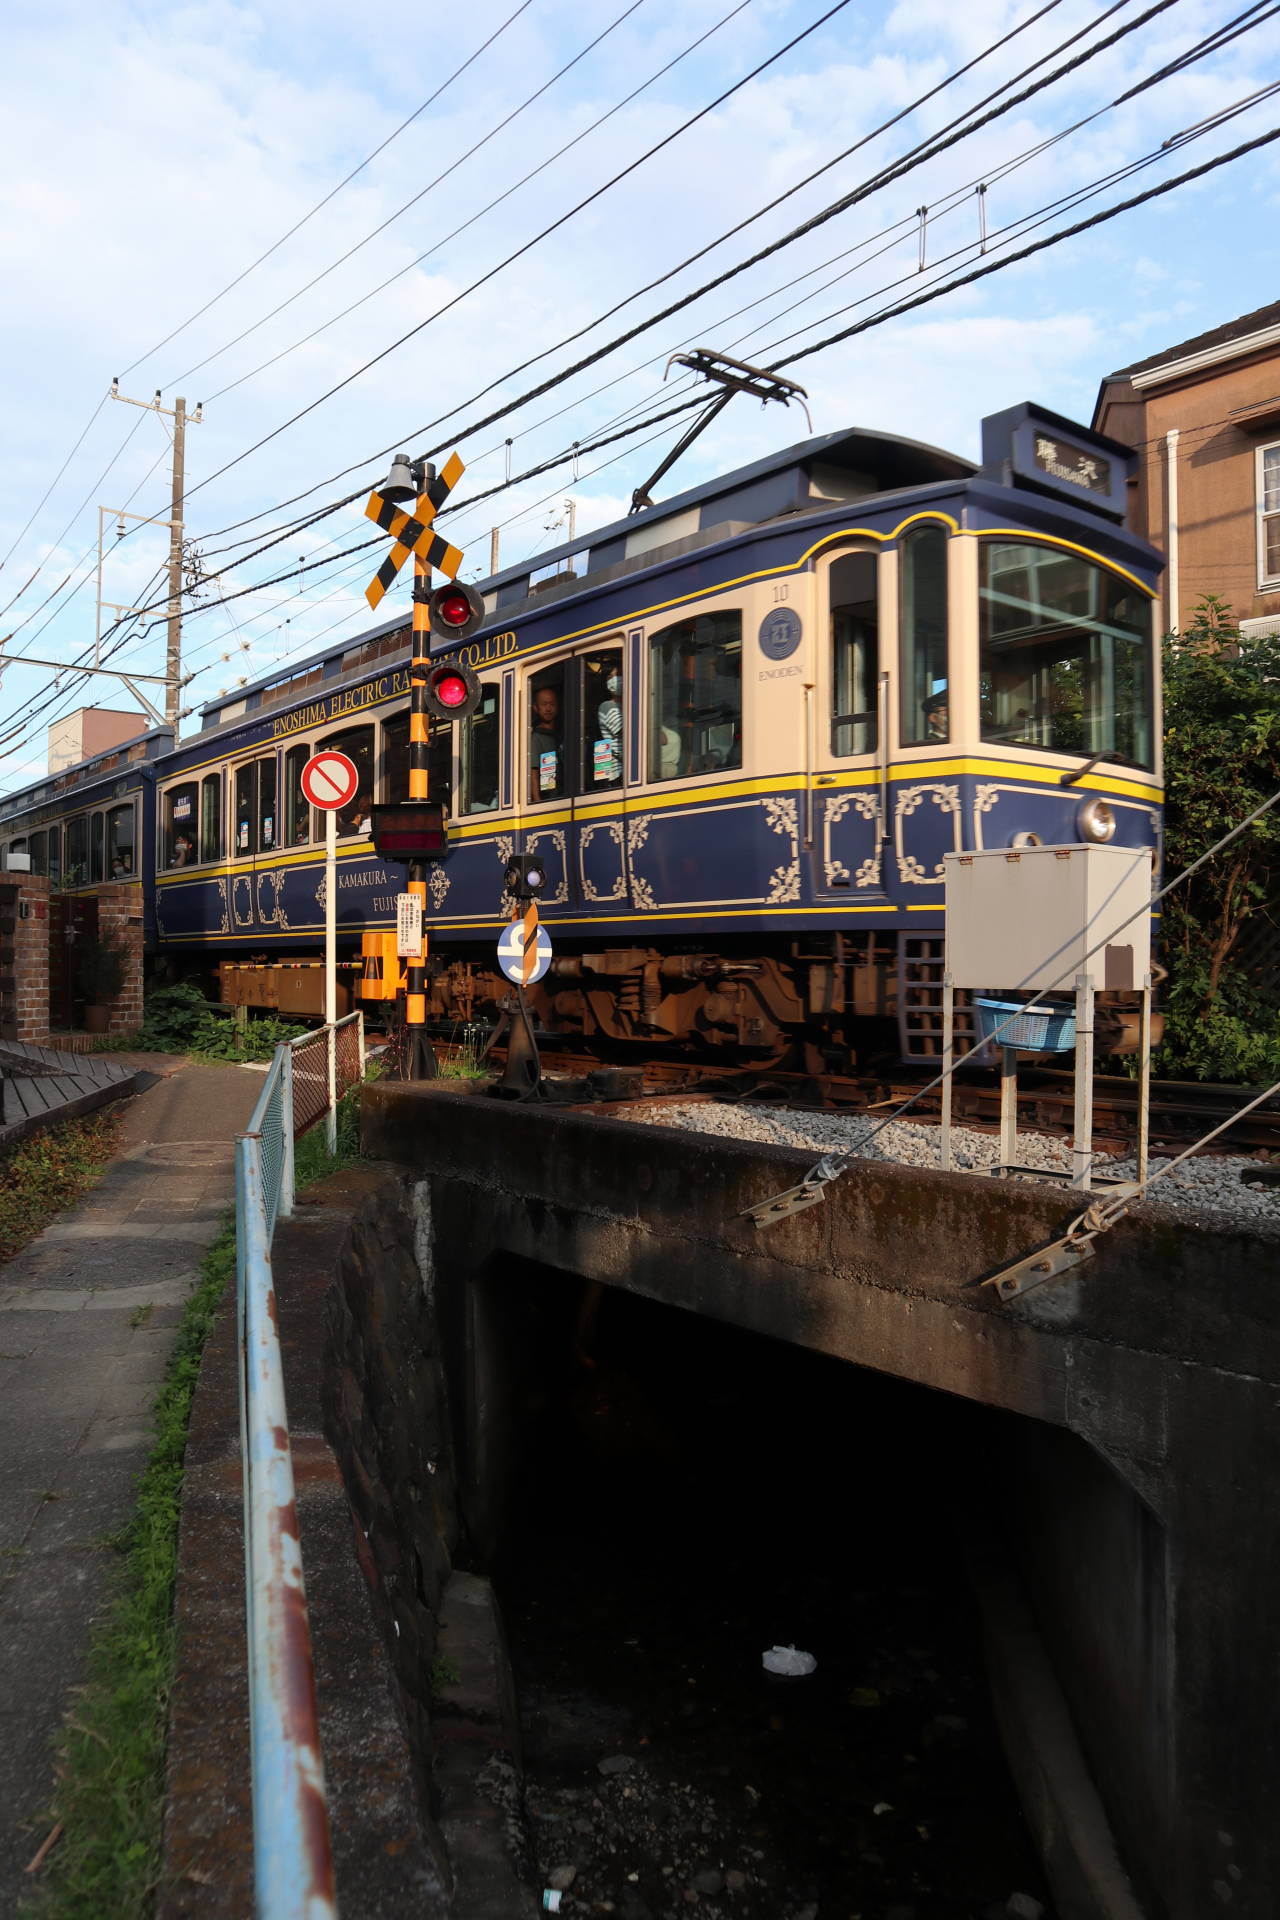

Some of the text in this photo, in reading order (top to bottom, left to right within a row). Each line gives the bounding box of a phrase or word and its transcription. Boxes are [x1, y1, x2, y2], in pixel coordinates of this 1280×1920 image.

[273, 701, 327, 736] ENOSHIMA
[331, 677, 388, 715] ELECTRIC
[339, 869, 387, 888] KAMAKURA
